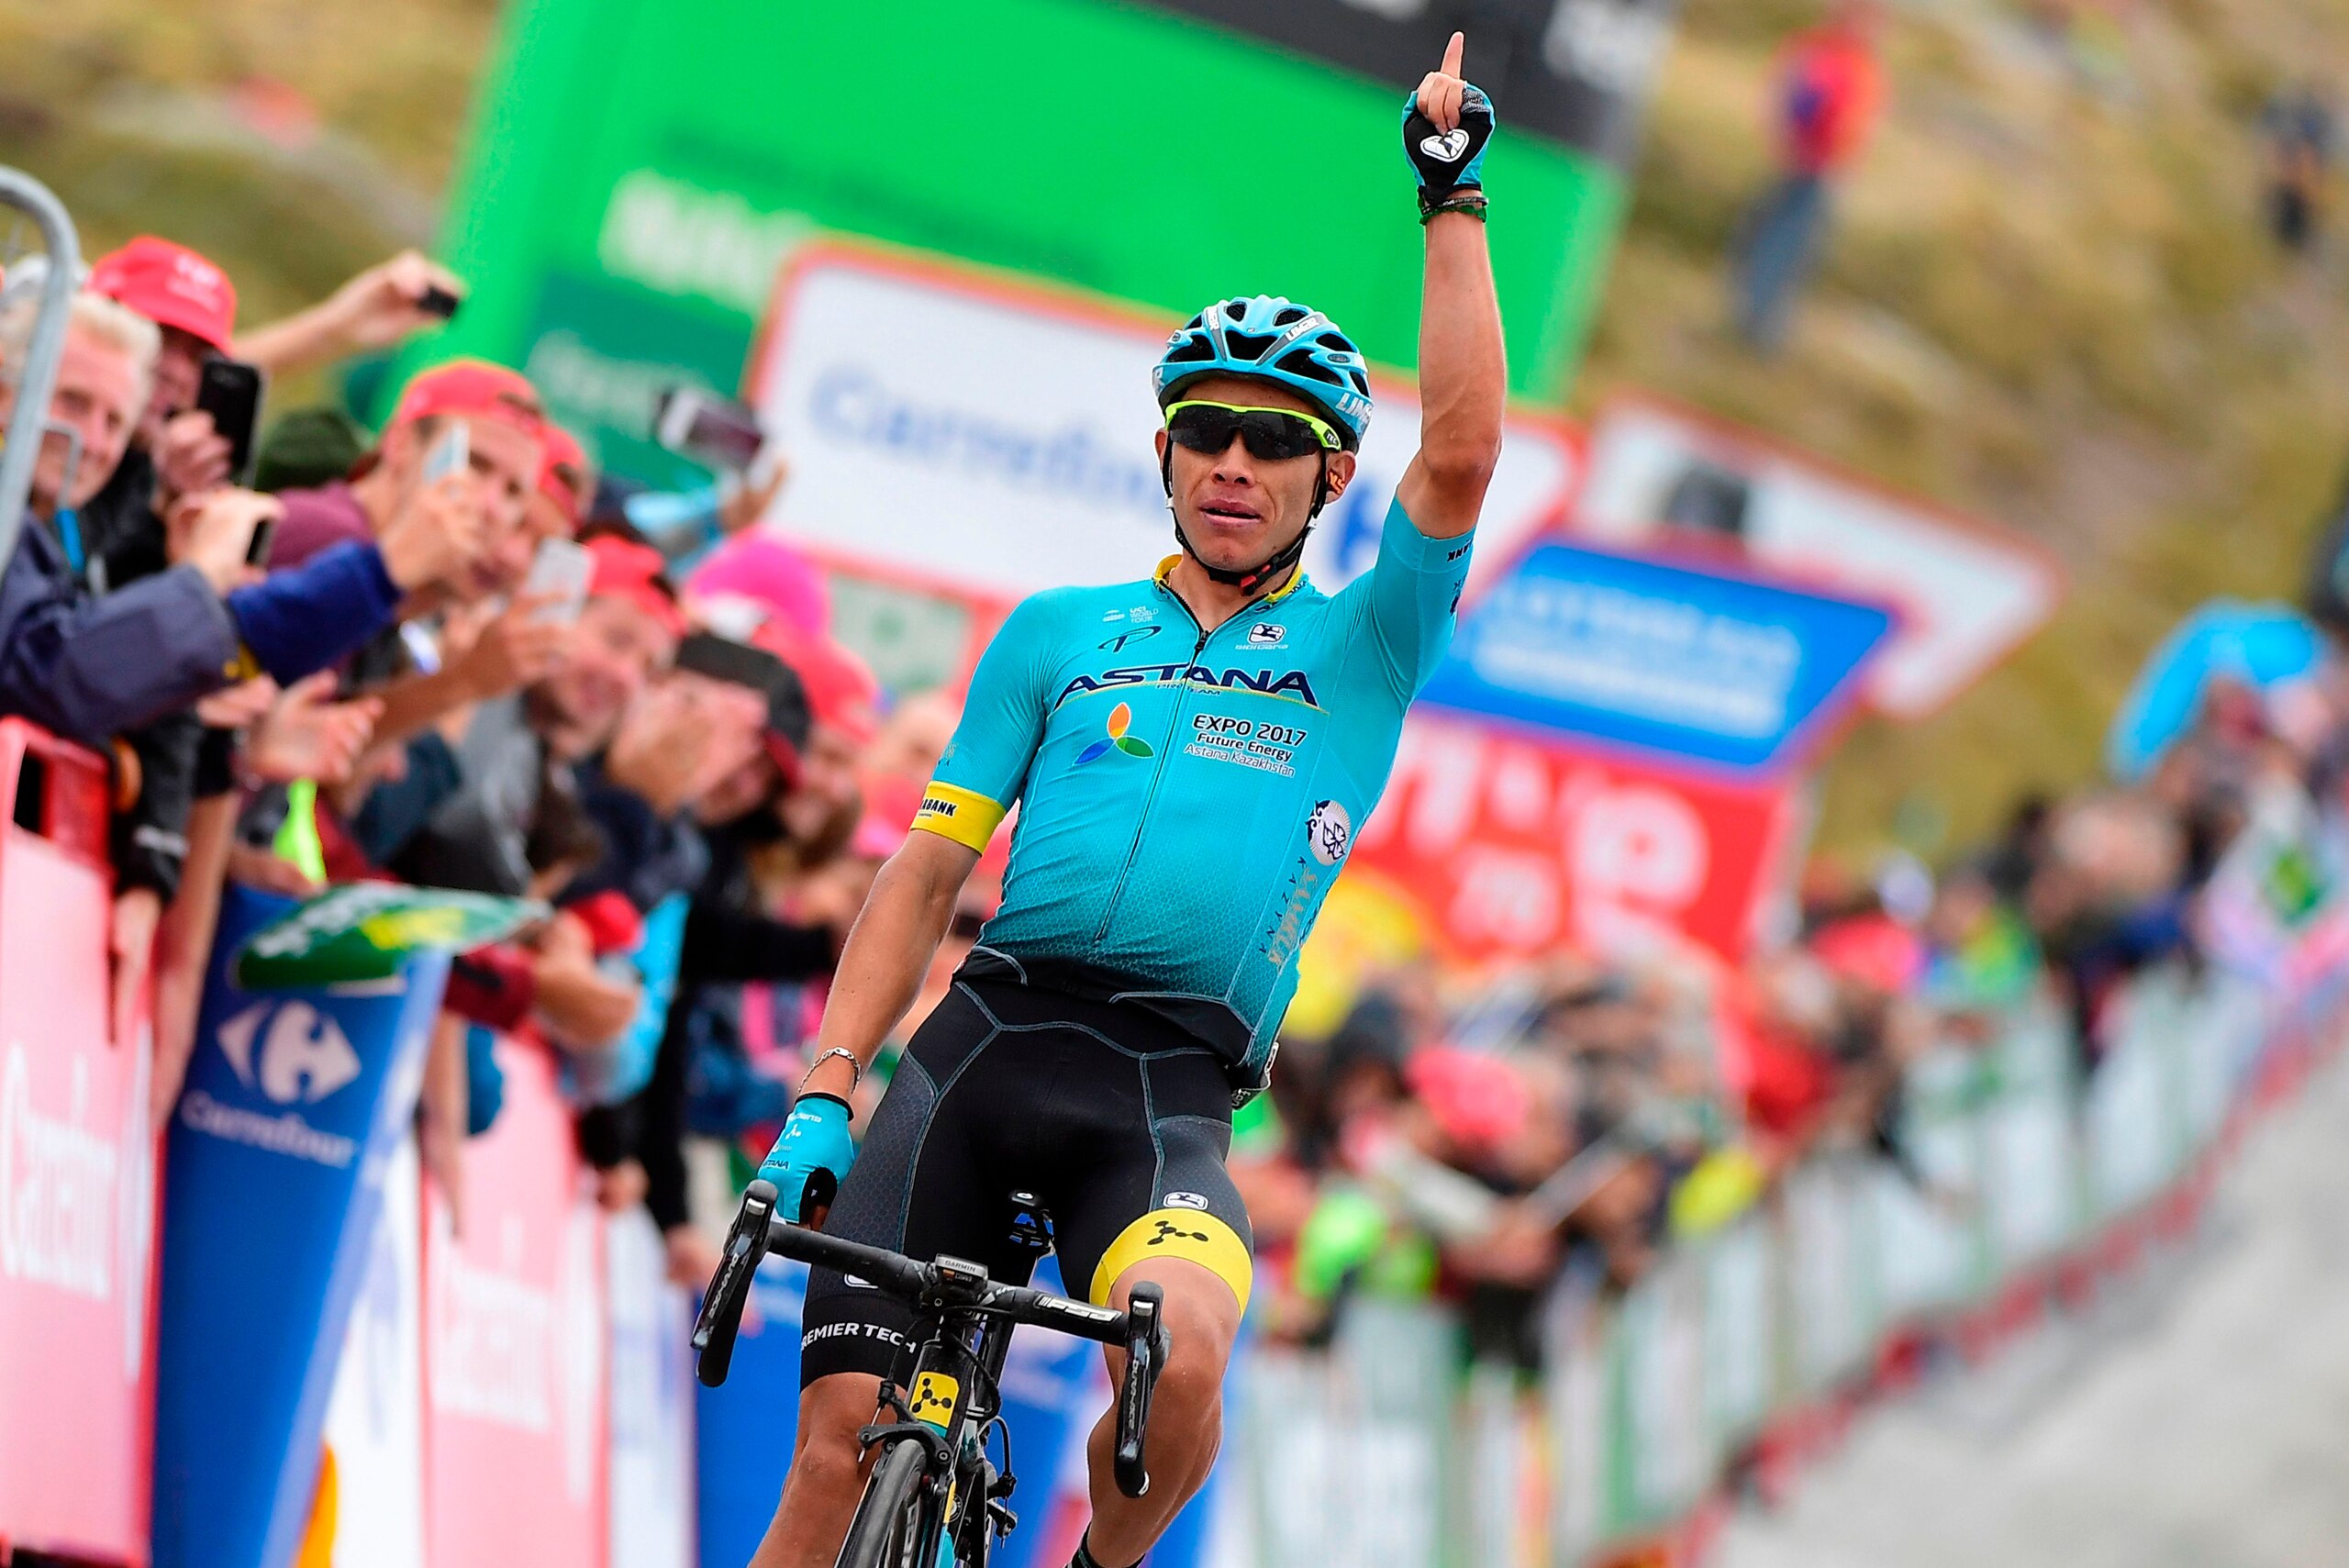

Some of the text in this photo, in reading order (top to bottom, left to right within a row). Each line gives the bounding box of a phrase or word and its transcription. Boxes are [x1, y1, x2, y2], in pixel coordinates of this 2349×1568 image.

[1054, 662, 1319, 710] ASTANA
[1192, 714, 1308, 747] EXPO 2017
[1184, 743, 1295, 777] Astana Kazakhstan
[1196, 732, 1293, 762] Future Energy
[945, 1260, 977, 1273] GARMIN
[801, 1322, 860, 1351] REMIER
